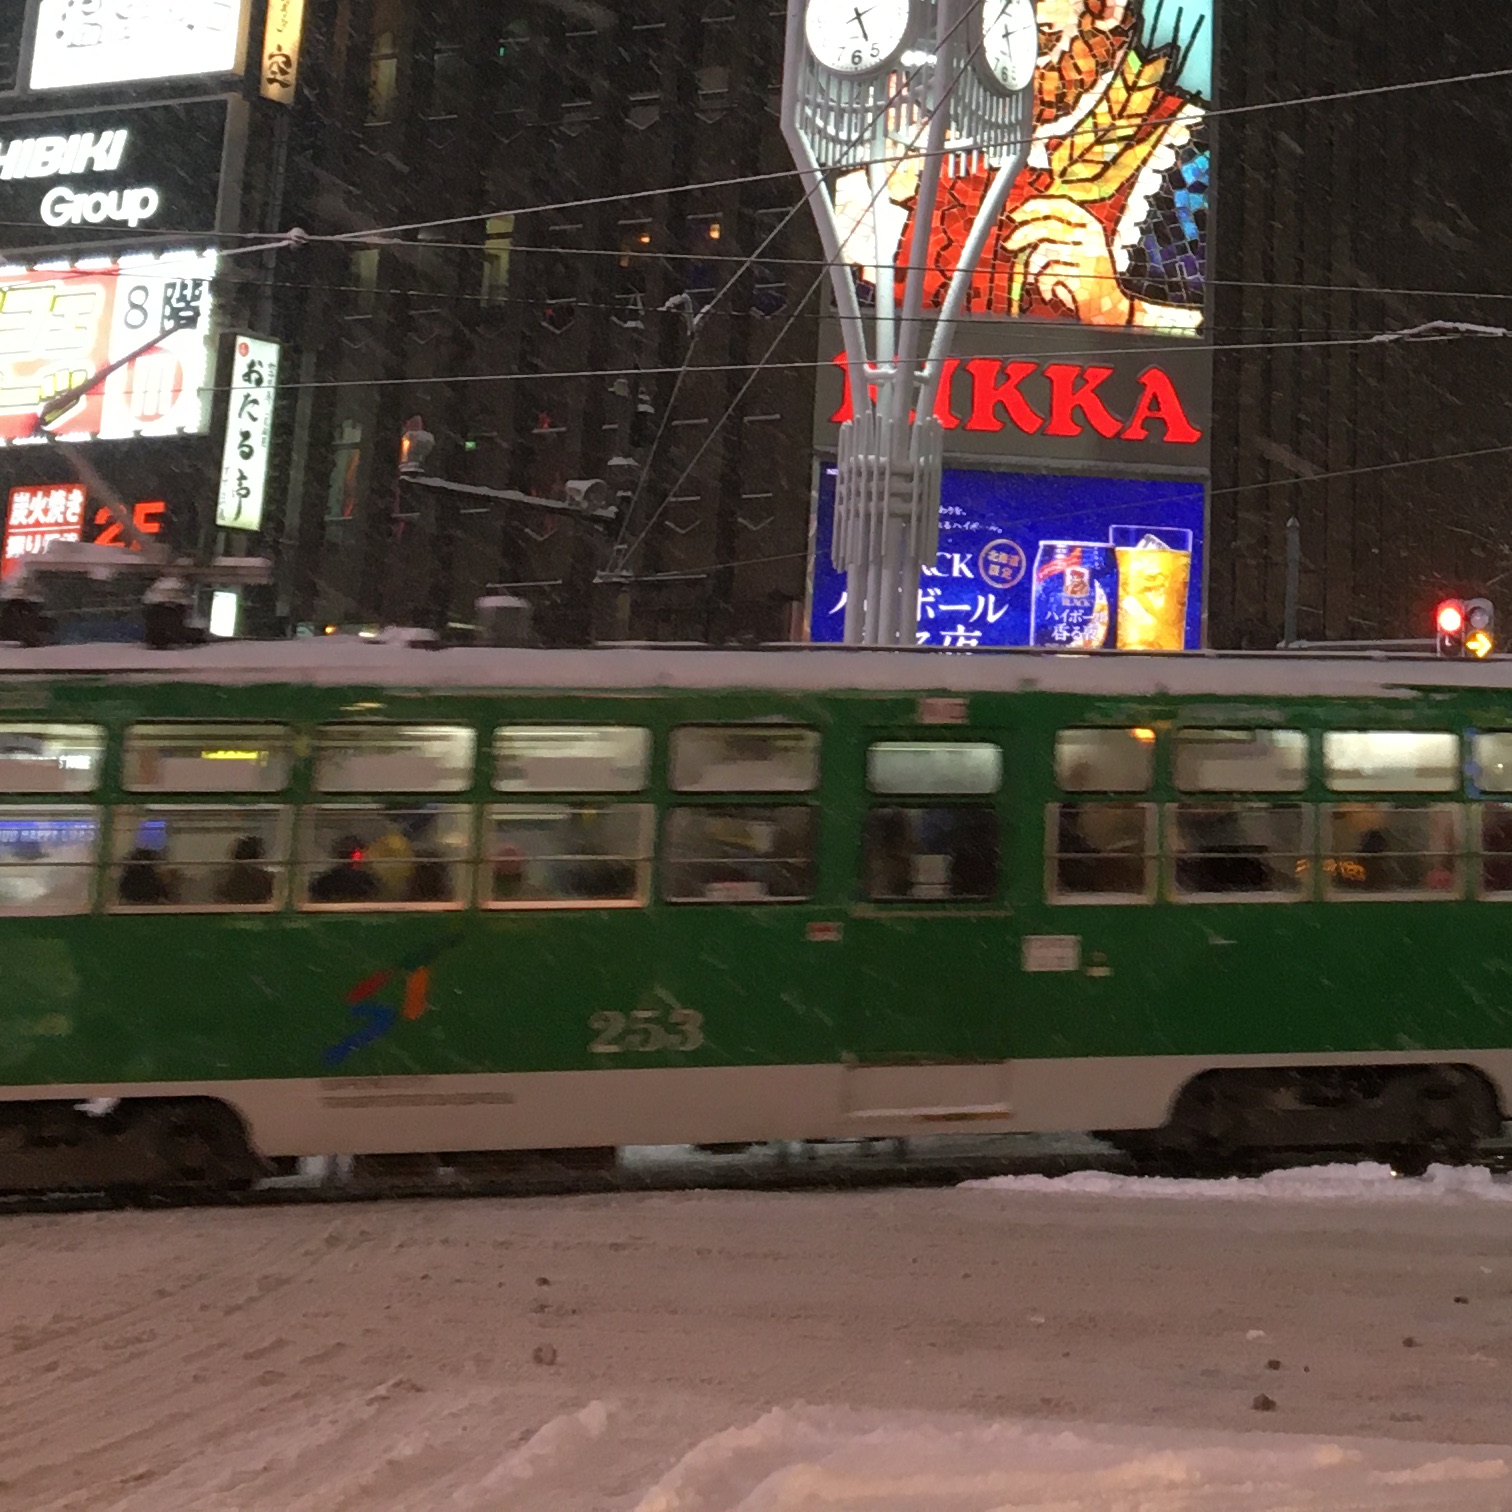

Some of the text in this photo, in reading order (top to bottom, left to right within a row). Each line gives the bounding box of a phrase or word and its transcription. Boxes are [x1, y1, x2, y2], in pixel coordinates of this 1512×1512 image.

[851, 49, 863, 66] 6
[870, 42, 881, 58] 5
[40, 186, 159, 228] Group
[587, 1008, 705, 1054] 253
